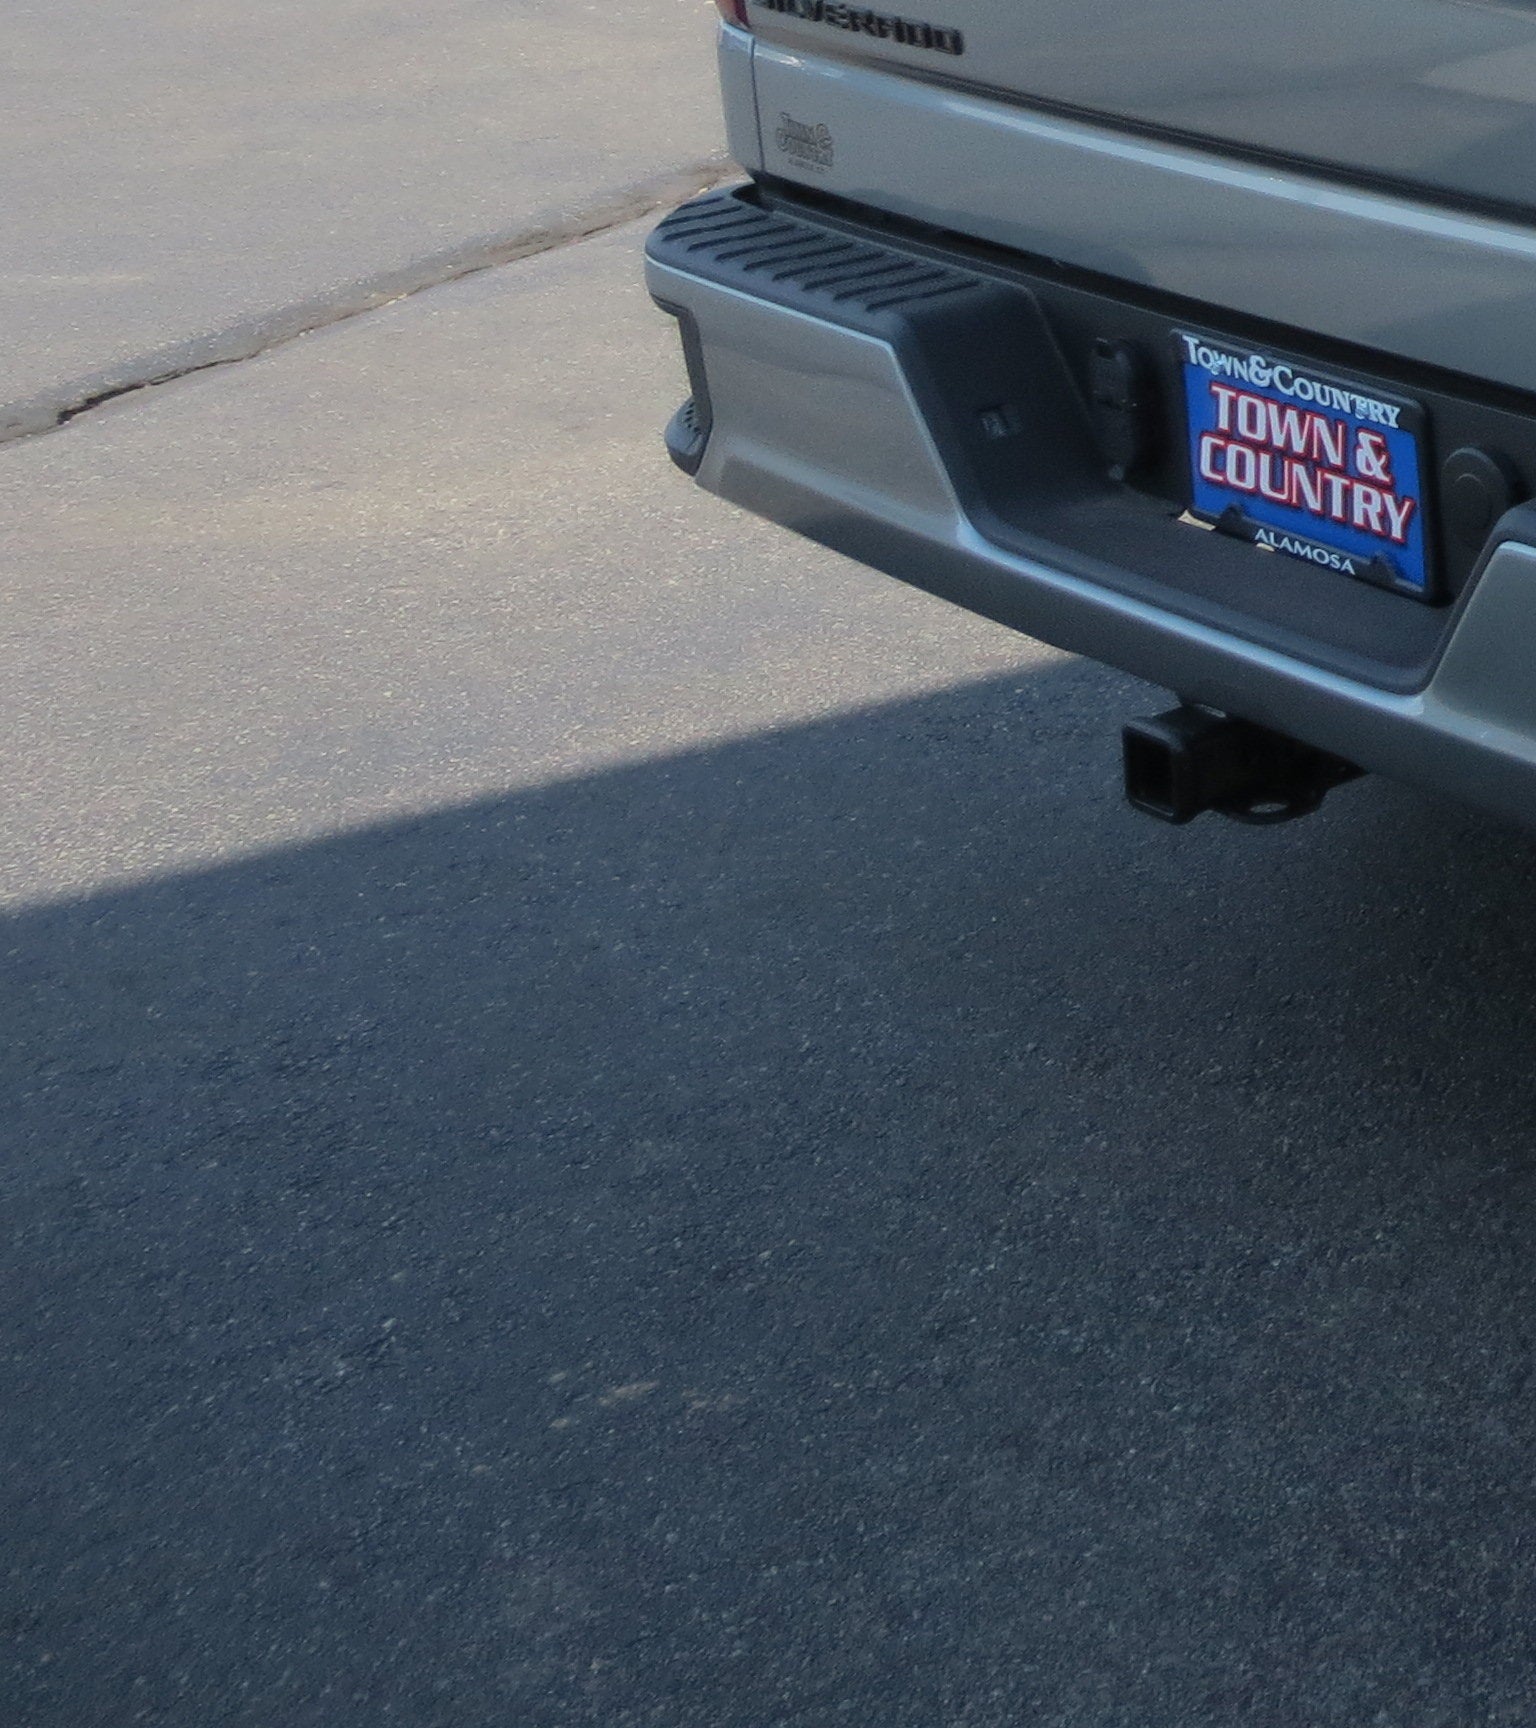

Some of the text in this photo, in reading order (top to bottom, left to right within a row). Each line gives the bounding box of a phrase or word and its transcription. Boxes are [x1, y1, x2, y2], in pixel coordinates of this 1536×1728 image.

[1209, 382, 1395, 486] TOWN &
[1199, 431, 1415, 545] COUNTRY
[1254, 528, 1356, 576] ALAMOSA
